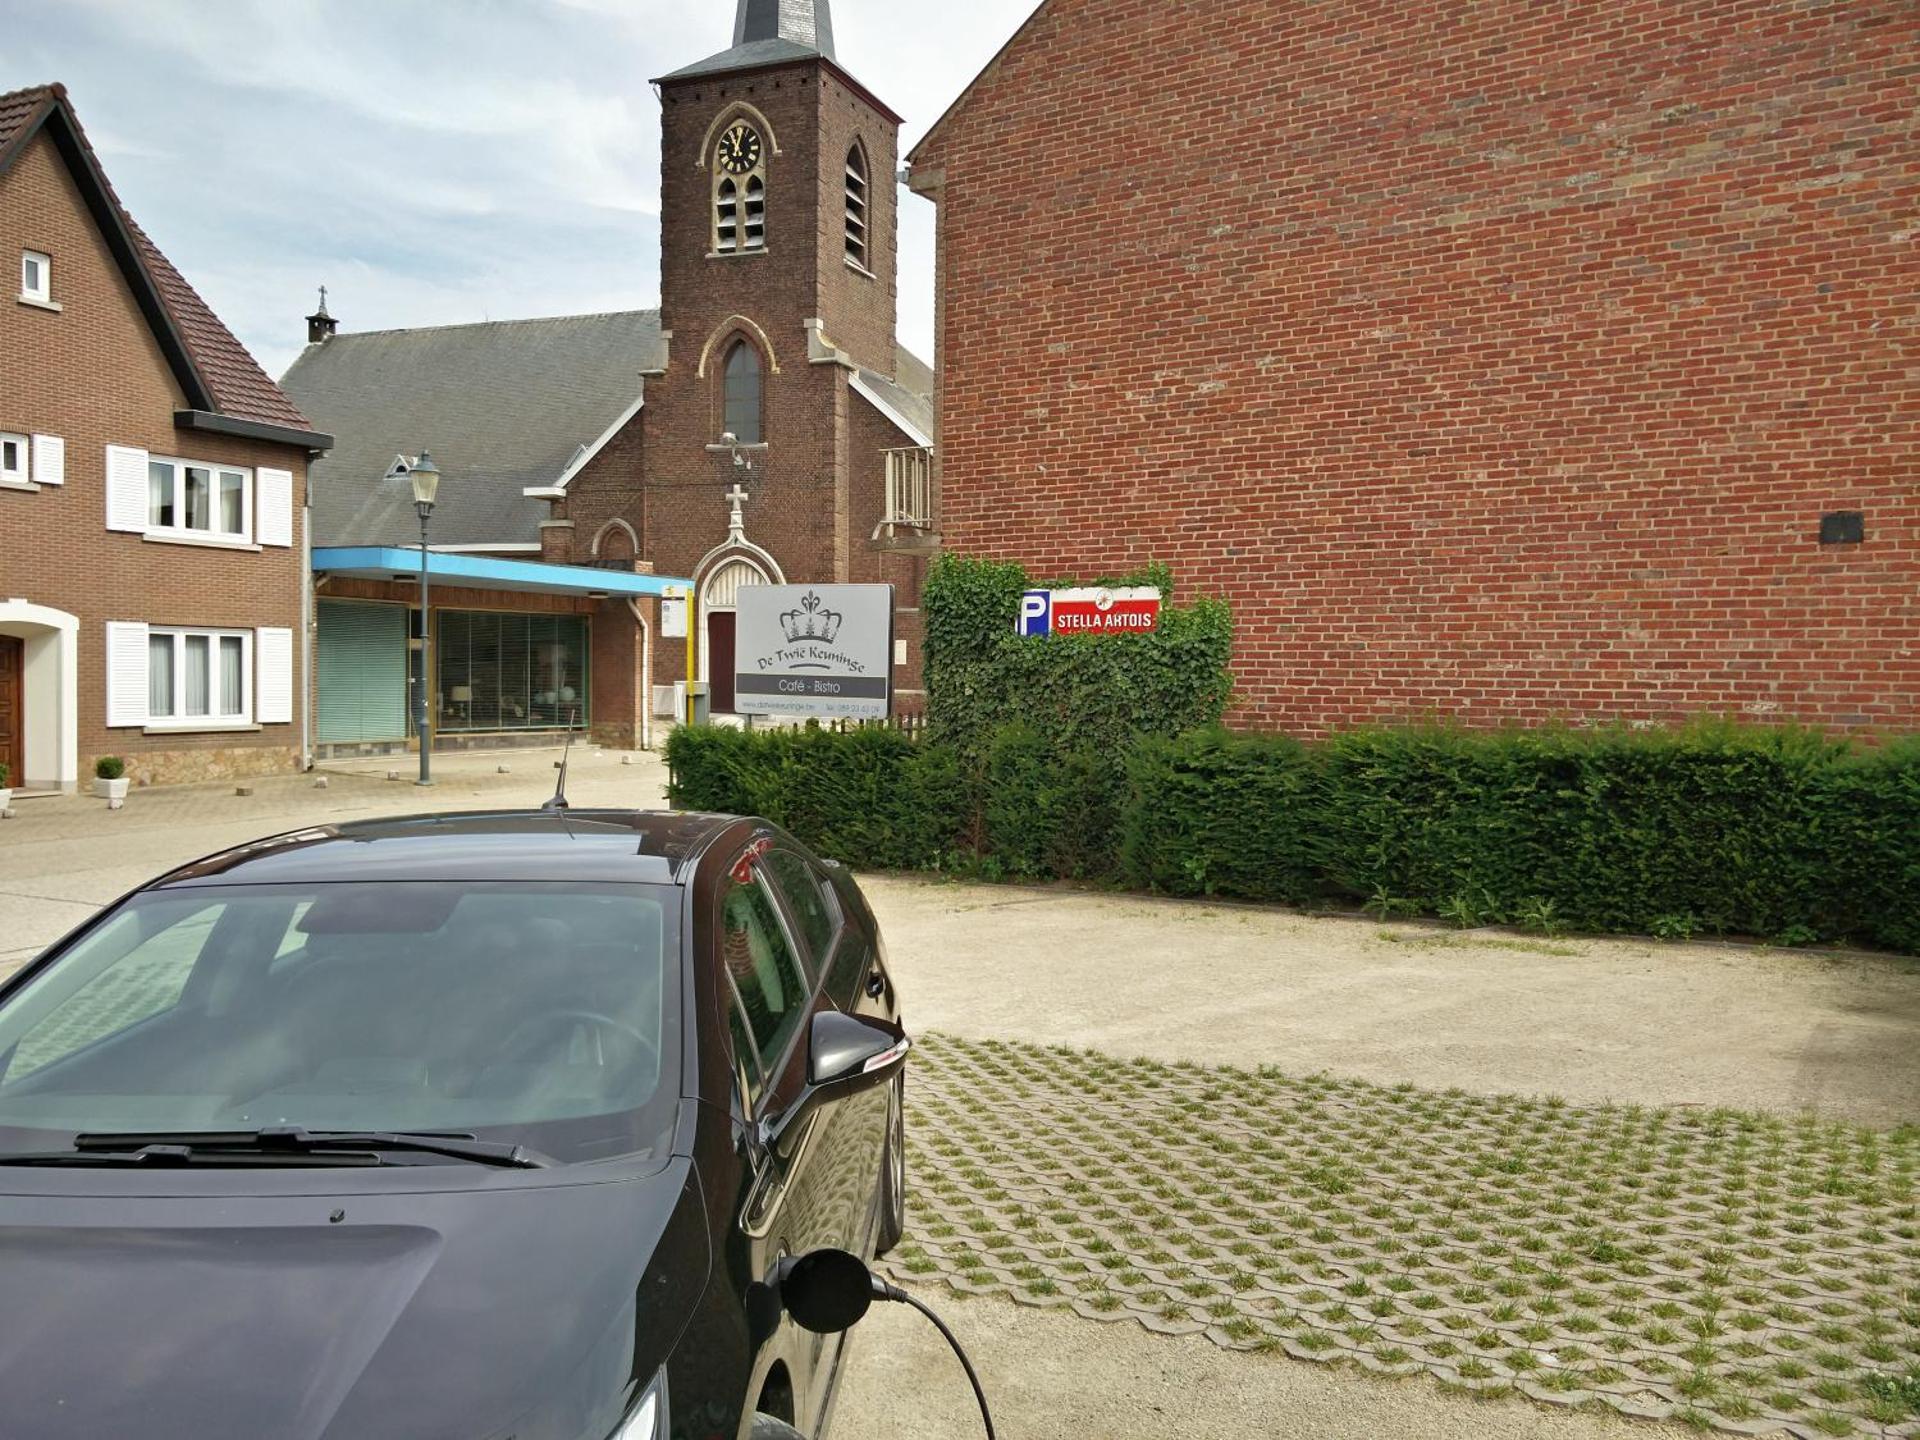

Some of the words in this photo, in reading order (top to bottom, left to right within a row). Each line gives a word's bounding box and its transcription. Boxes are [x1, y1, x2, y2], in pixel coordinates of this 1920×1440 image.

[1021, 596, 1046, 635] P
[1058, 614, 1101, 628] STELLA
[1105, 613, 1151, 627] ARTOIS
[756, 656, 771, 670] De
[809, 646, 866, 673] Keuninge
[779, 679, 805, 692] Café
[814, 681, 841, 694] Bistro
